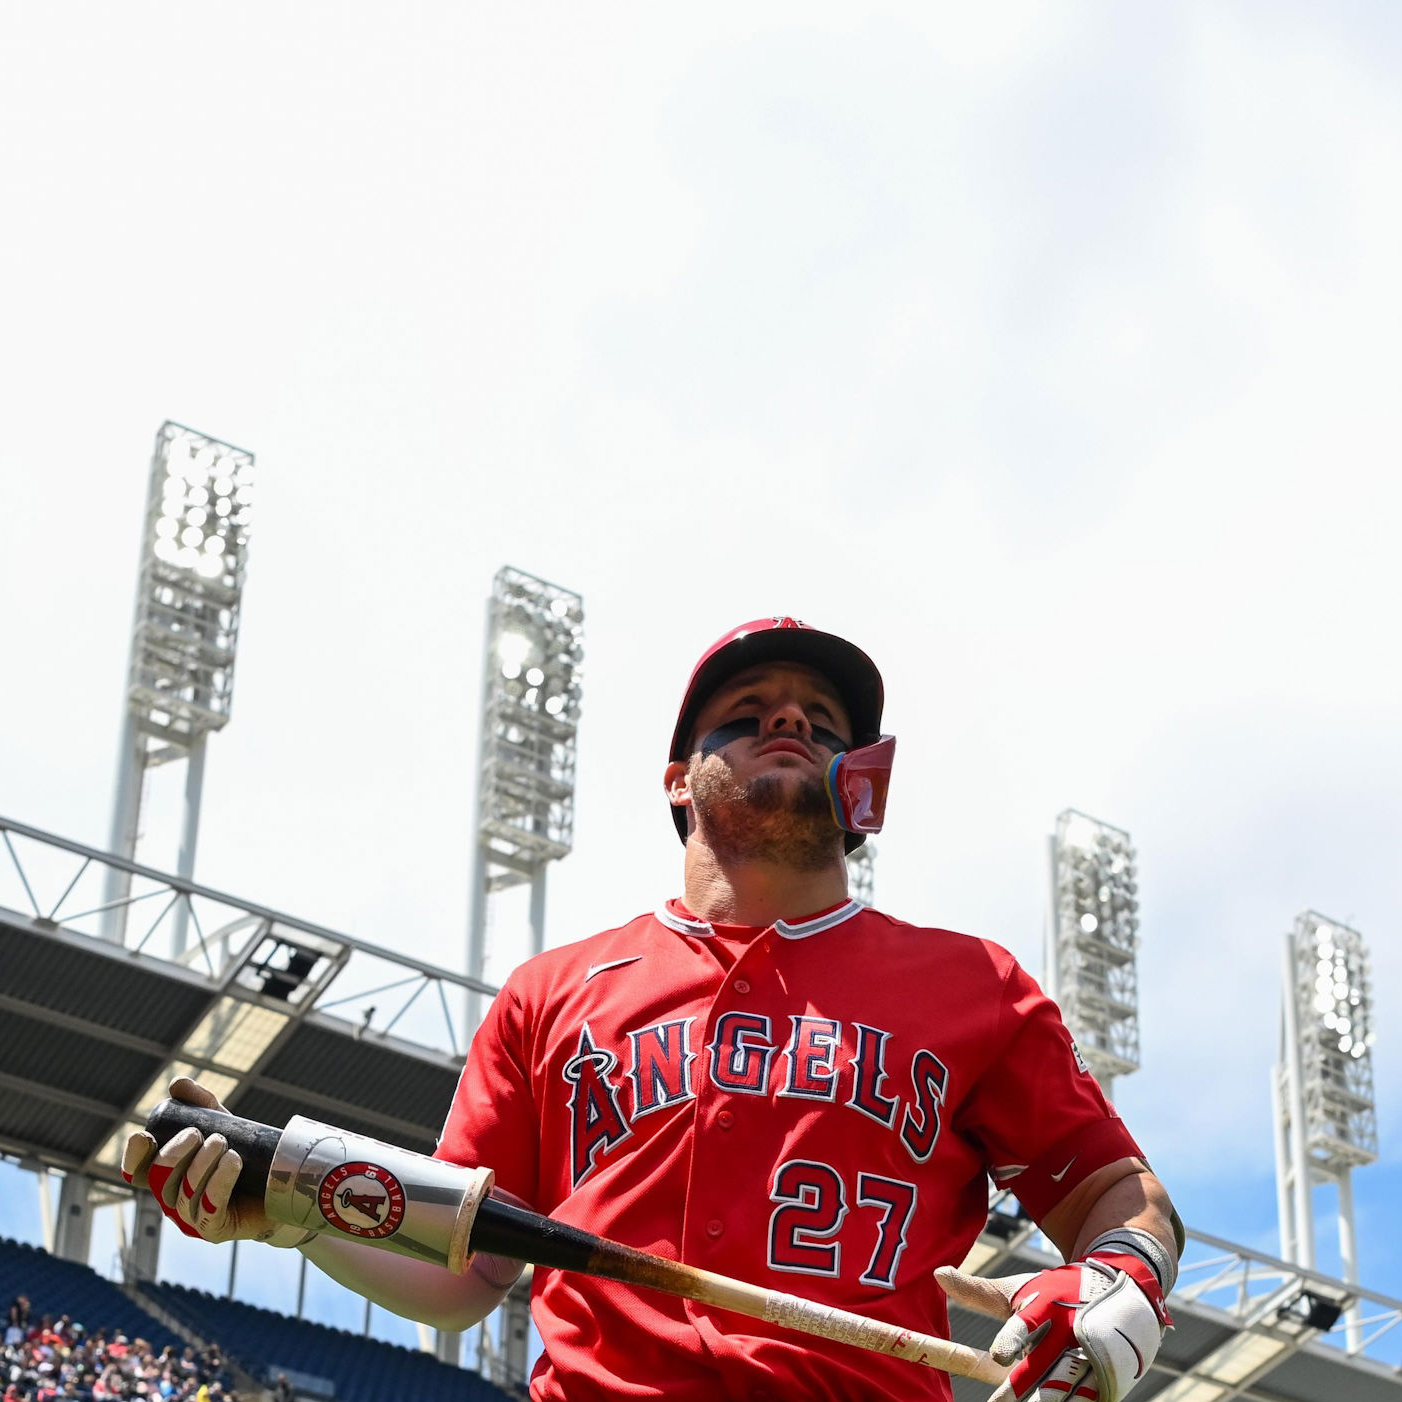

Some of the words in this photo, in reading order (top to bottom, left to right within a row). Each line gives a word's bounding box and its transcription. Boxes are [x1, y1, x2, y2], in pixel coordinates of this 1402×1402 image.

[563, 1011, 949, 1193] ANGELS
[321, 1166, 348, 1219] ANGELS
[368, 1175, 402, 1237] BASEBALL
[767, 1159, 918, 1290] 27
